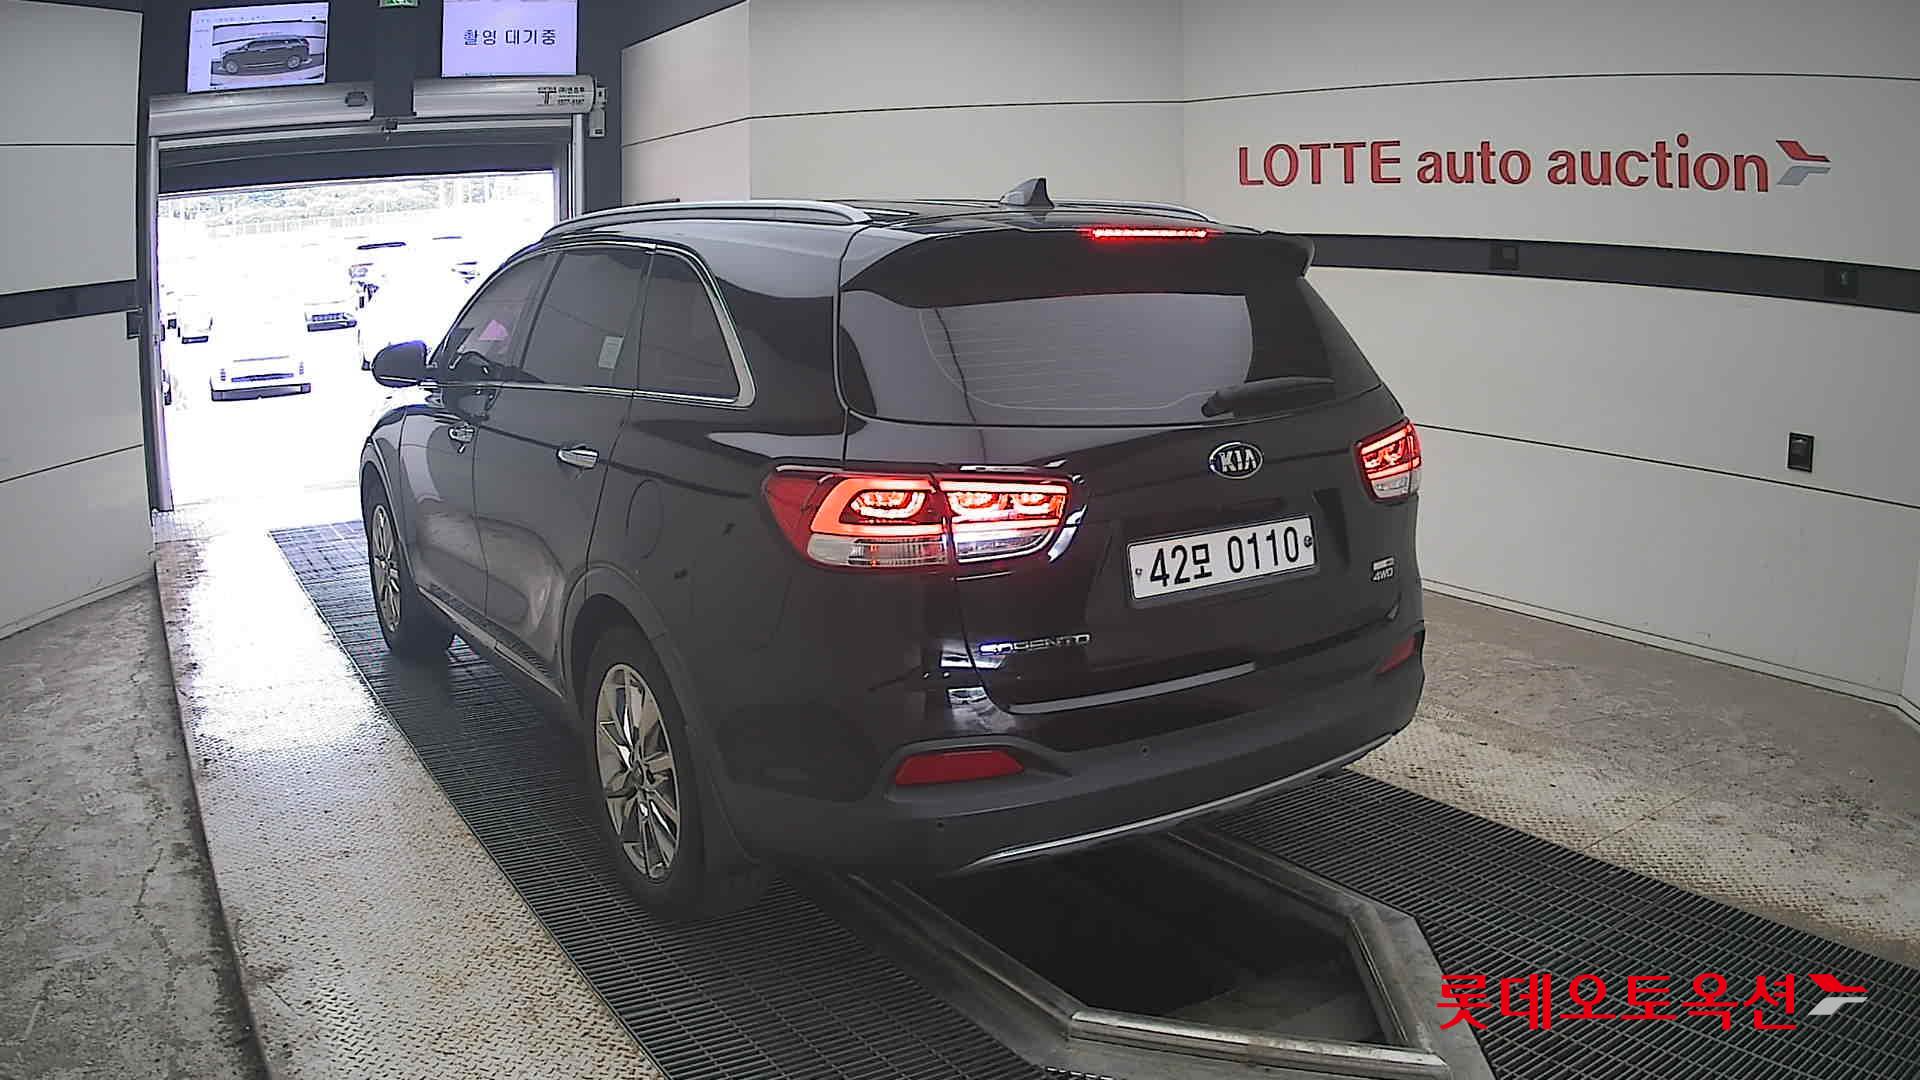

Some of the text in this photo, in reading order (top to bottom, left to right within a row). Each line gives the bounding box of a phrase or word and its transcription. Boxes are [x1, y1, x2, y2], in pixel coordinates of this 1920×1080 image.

[505, 29, 556, 46] 대기중
[1238, 133, 1770, 193] LOTTE auto auction
[1217, 449, 1257, 472] KIA
[1149, 526, 1300, 587] 42모 0110
